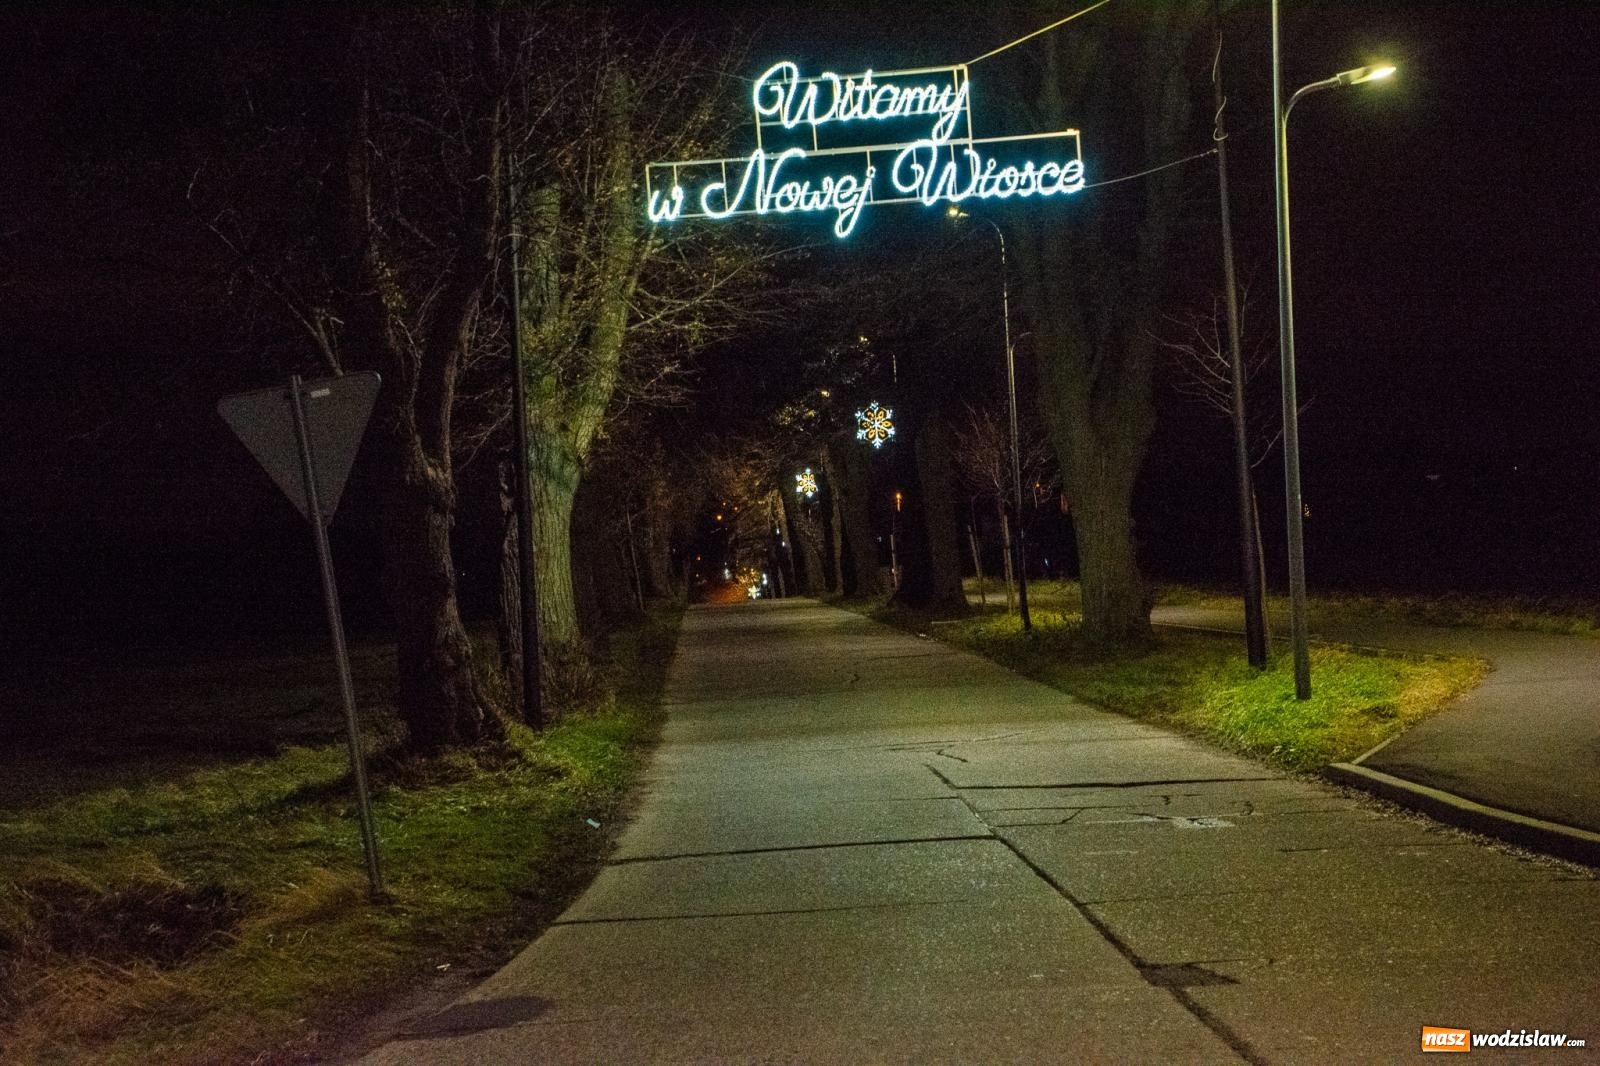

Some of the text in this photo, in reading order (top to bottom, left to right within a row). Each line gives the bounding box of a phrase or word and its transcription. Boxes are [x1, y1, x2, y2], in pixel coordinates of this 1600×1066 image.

[753, 61, 970, 143] Witamy
[647, 139, 1085, 238] w Nowej Wiosce
